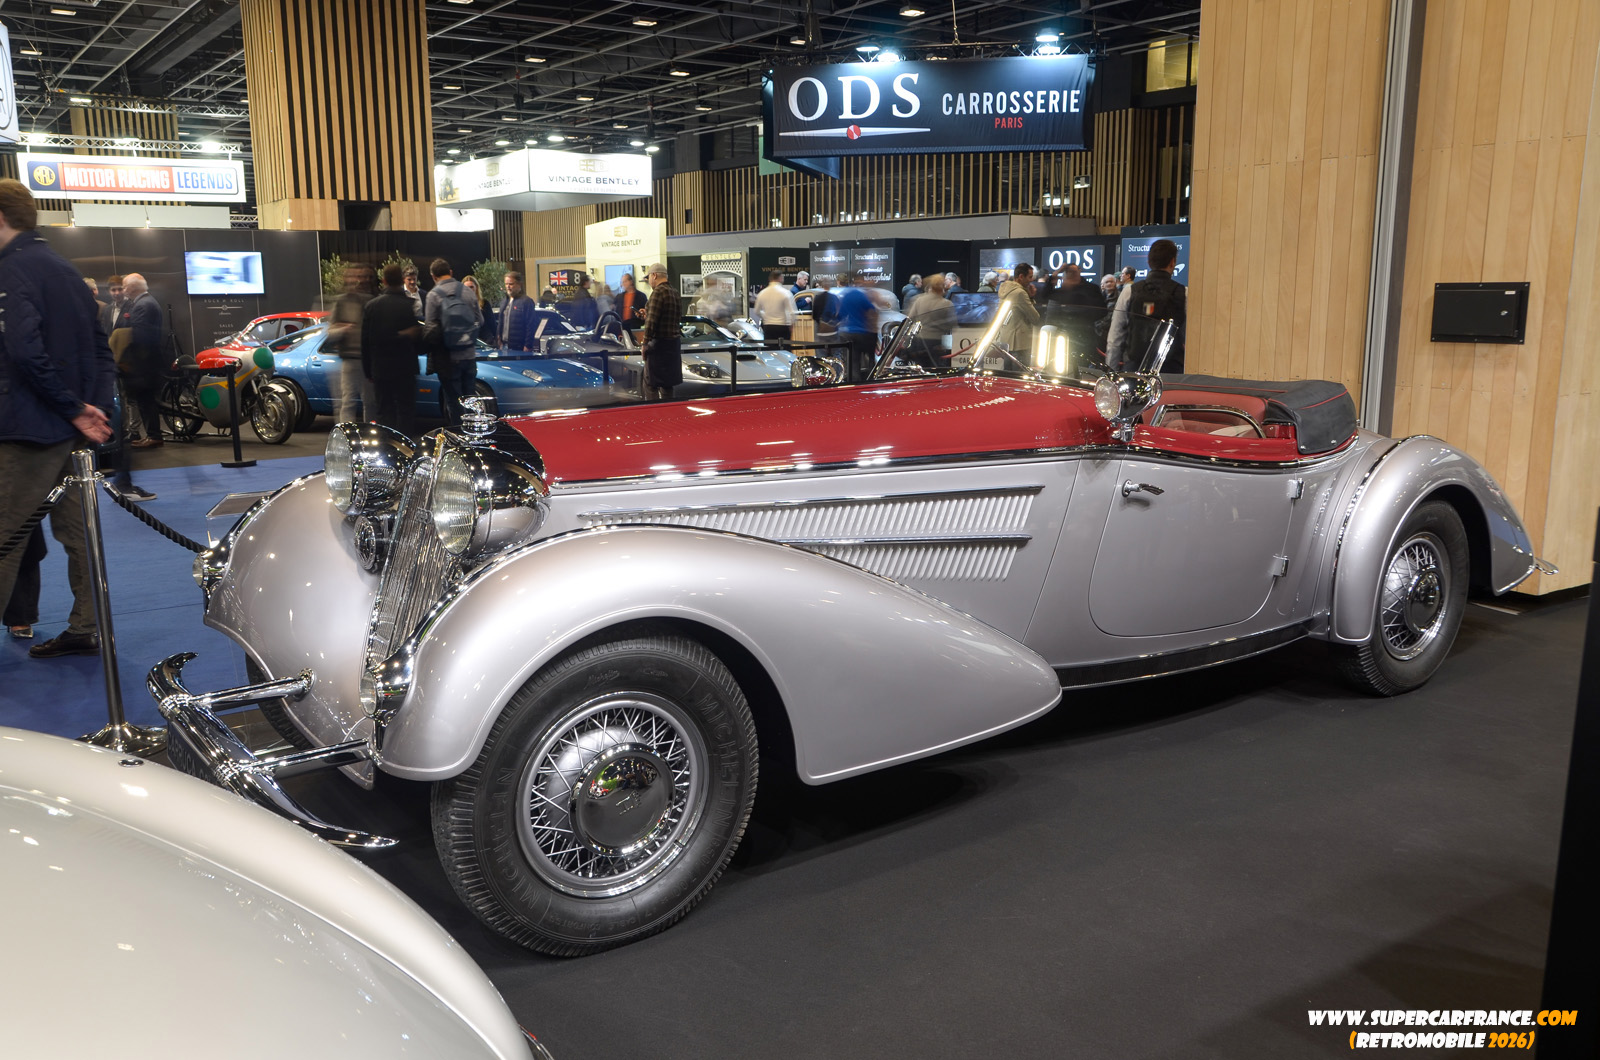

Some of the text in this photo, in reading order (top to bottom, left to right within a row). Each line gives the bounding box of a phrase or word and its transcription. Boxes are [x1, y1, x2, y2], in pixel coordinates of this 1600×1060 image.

[787, 72, 1081, 122] ODS CARROSSERIE
[994, 117, 1023, 129] PARIS
[64, 167, 233, 190] MOTOR RACING LEGENDS
[548, 175, 640, 186] VINTAGE BENTLEY
[621, 239, 642, 247] BENTLEY
[1128, 243, 1151, 252] Structu
[1049, 249, 1094, 270] ODS
[574, 272, 581, 284] 8
[959, 357, 998, 365] CARERIE
[695, 693, 740, 828] MICHELIN
